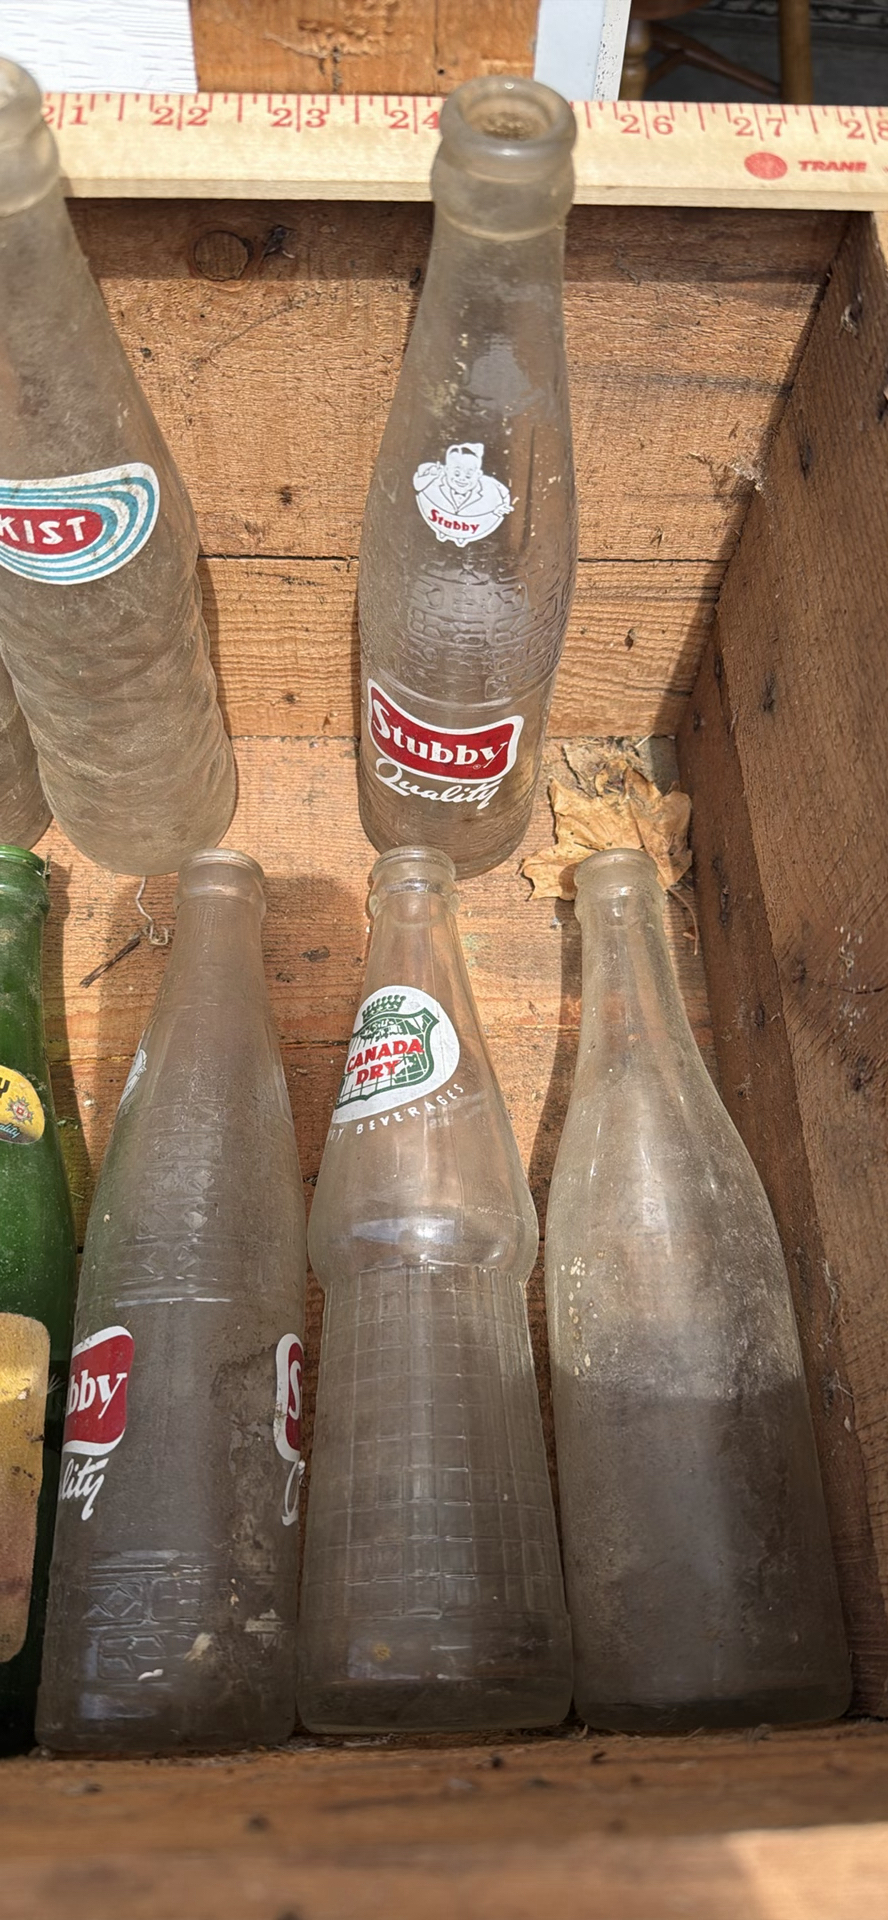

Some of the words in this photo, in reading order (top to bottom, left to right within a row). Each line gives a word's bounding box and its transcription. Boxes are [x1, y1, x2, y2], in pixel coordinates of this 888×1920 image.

[153, 106, 209, 127] 22
[272, 108, 328, 129] 23
[620, 114, 674, 136] 26
[733, 116, 787, 138] 27
[798, 159, 867, 173] TRANE
[428, 508, 481, 535] Stubby
[372, 698, 508, 770] Stubby
[374, 757, 504, 810] Quality
[346, 1038, 425, 1073] CANADA
[355, 1060, 401, 1087] DRY
[356, 1083, 465, 1136] BEVERAGES
